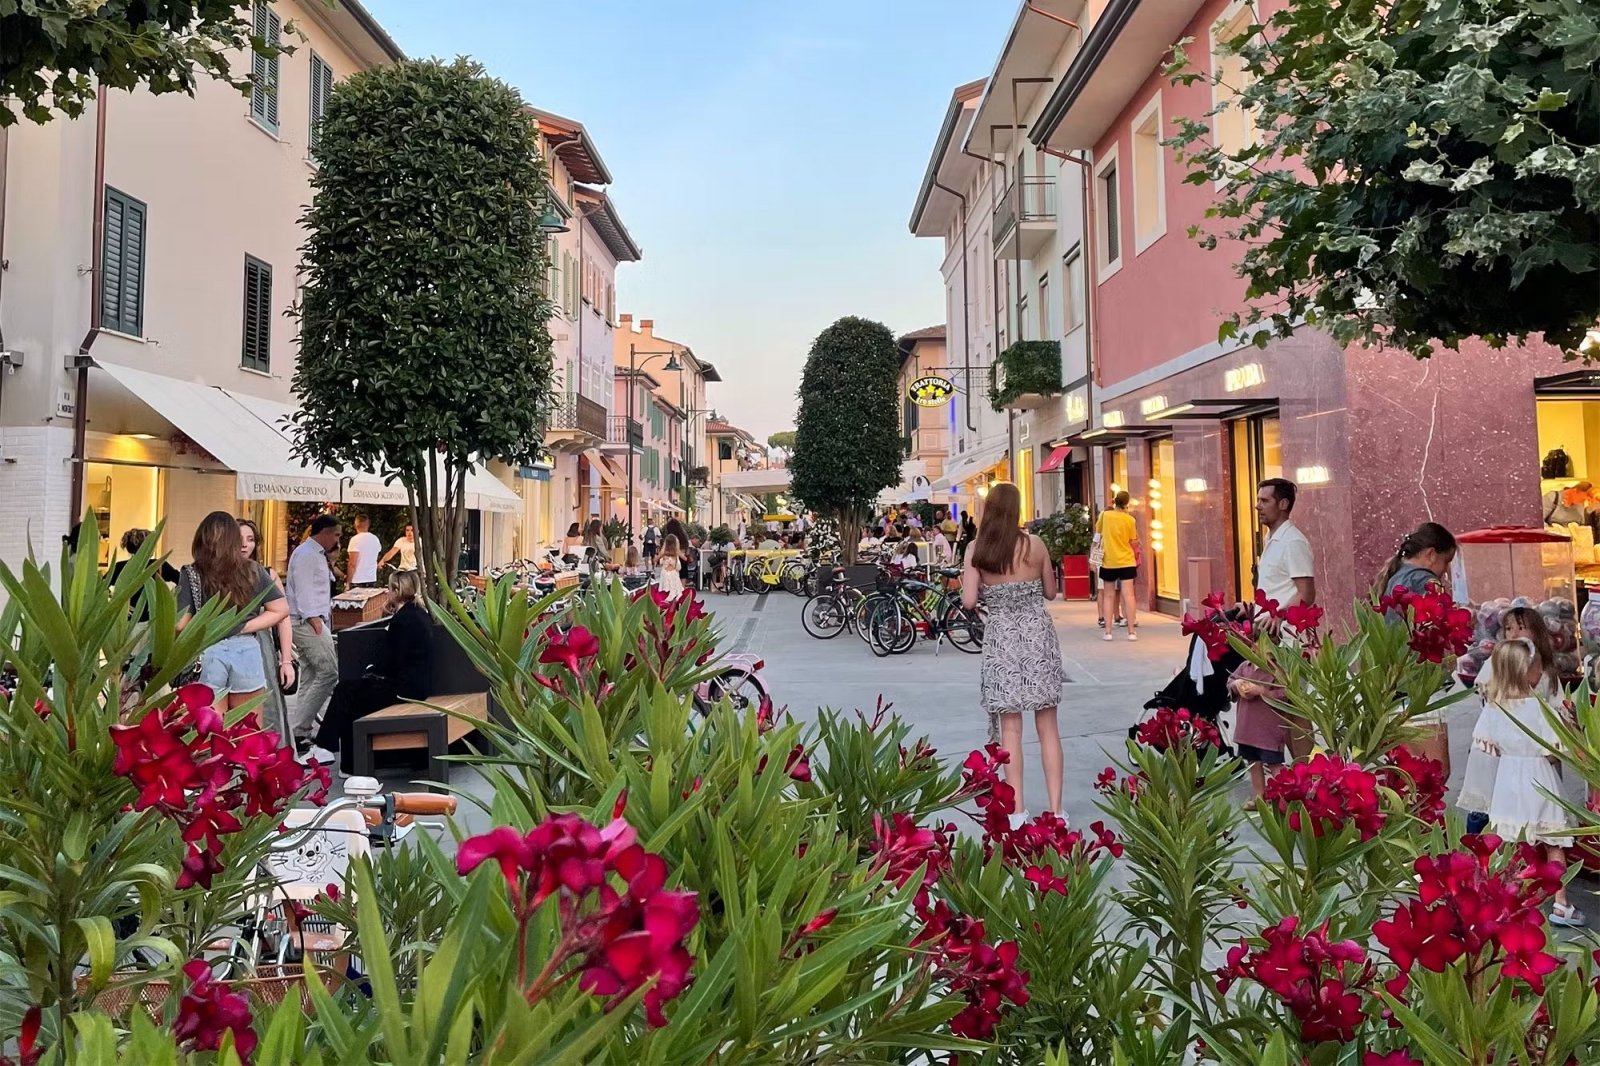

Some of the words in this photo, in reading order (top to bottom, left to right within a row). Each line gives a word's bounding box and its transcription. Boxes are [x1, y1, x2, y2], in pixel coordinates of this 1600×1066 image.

[911, 378, 951, 392] TRATTORIA
[253, 483, 291, 495] ERMANNO
[293, 485, 328, 496] SCERVINO
